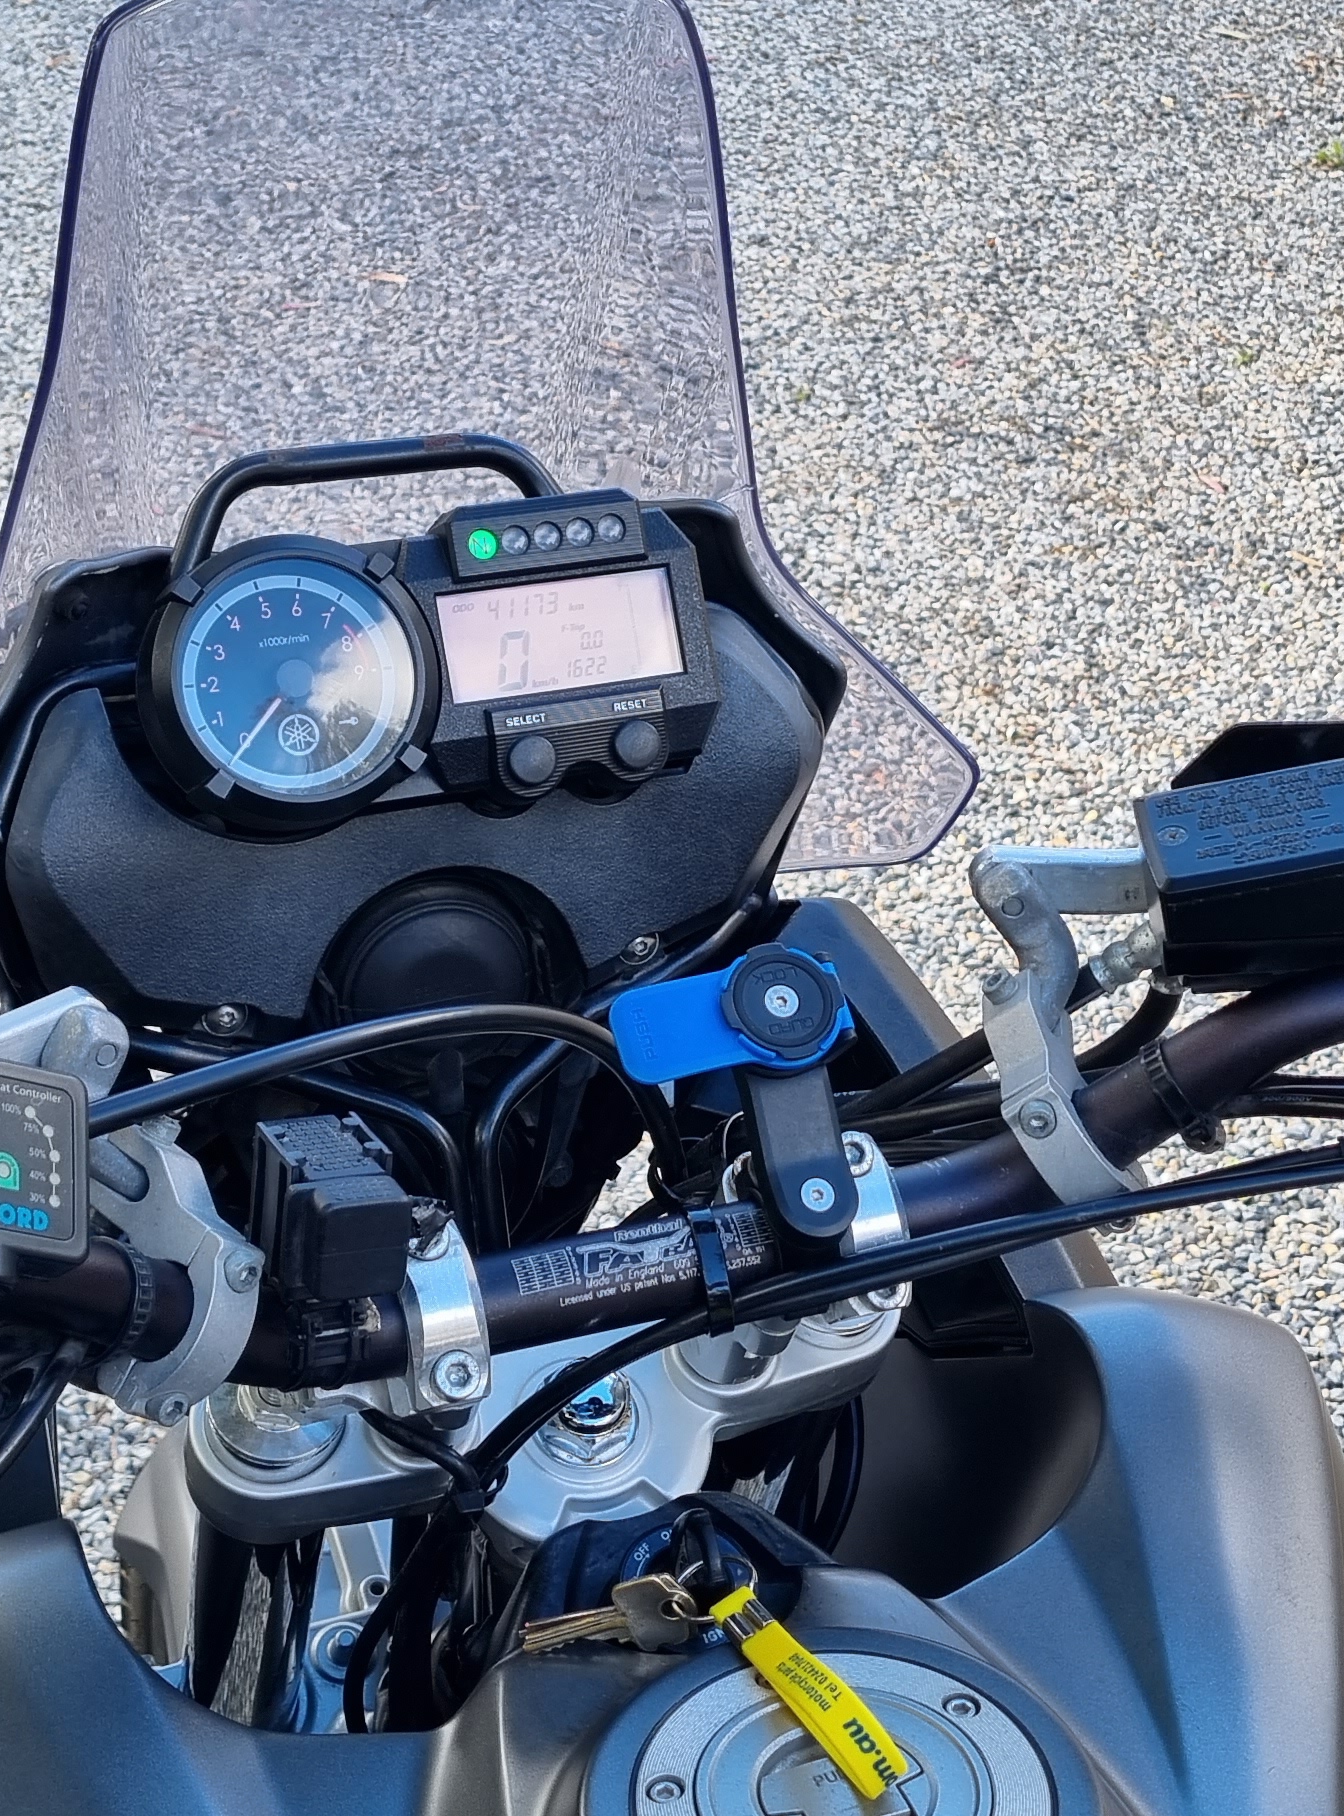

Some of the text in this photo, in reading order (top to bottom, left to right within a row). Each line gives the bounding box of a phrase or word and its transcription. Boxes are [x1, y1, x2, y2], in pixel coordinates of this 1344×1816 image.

[261, 603, 272, 619] 5
[291, 601, 302, 617] 6
[452, 591, 585, 620] ODO 41173 km
[230, 616, 241, 632] 4
[321, 612, 331, 629] 7
[258, 633, 310, 648] x1000r/min
[341, 635, 353, 652] 8
[213, 645, 225, 660] 3
[498, 629, 530, 692] 0
[354, 665, 364, 681] 9
[207, 677, 220, 693] 2
[612, 697, 648, 712] RESET
[505, 712, 546, 727] SELECT
[239, 732, 252, 748] 0
[752, 966, 798, 985] LOCK
[768, 1016, 815, 1036] QUAD
[13, 1085, 62, 1104] Controller
[1, 1102, 22, 1115] 100%
[23, 1122, 40, 1135] 75%
[29, 1147, 46, 1160] 50%
[29, 1170, 46, 1182] 40%
[29, 1192, 46, 1204] 30%
[614, 1218, 684, 1242] Renthal
[585, 1275, 610, 1289] Made
[628, 1263, 665, 1280] England
[560, 1290, 593, 1307] Licensed
[596, 1286, 617, 1298] under
[620, 1282, 631, 1293] US
[635, 1277, 659, 1292] patent
[633, 1542, 650, 1561] OFF
[789, 1672, 832, 1713] motorcycle
[824, 1682, 842, 1702] Tel
